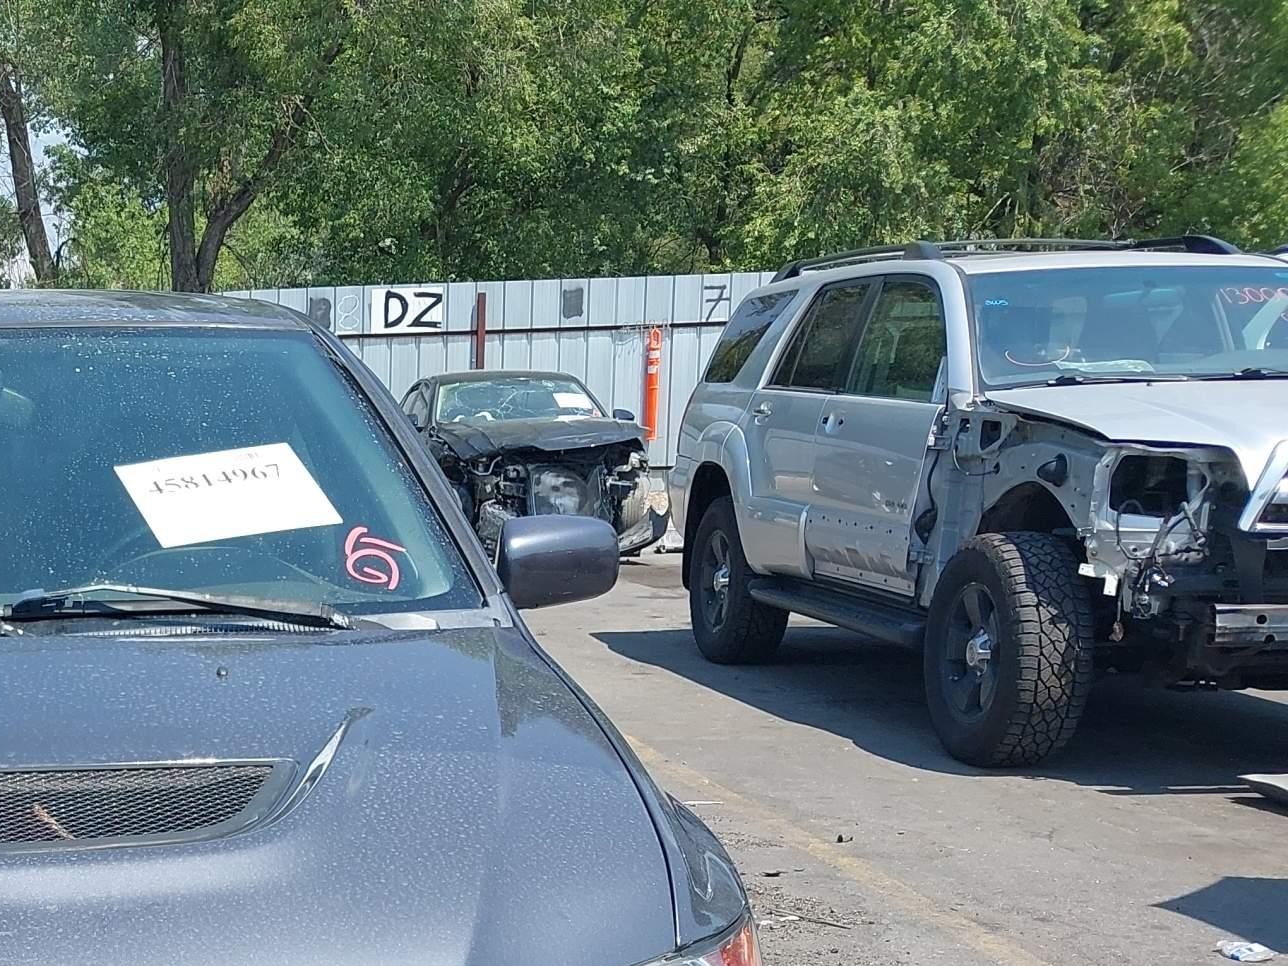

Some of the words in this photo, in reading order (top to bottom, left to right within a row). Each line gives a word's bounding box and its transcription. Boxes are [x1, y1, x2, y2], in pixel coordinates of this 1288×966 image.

[384, 290, 443, 328] DZ
[704, 284, 730, 321] 7
[148, 463, 280, 494] 45814967
